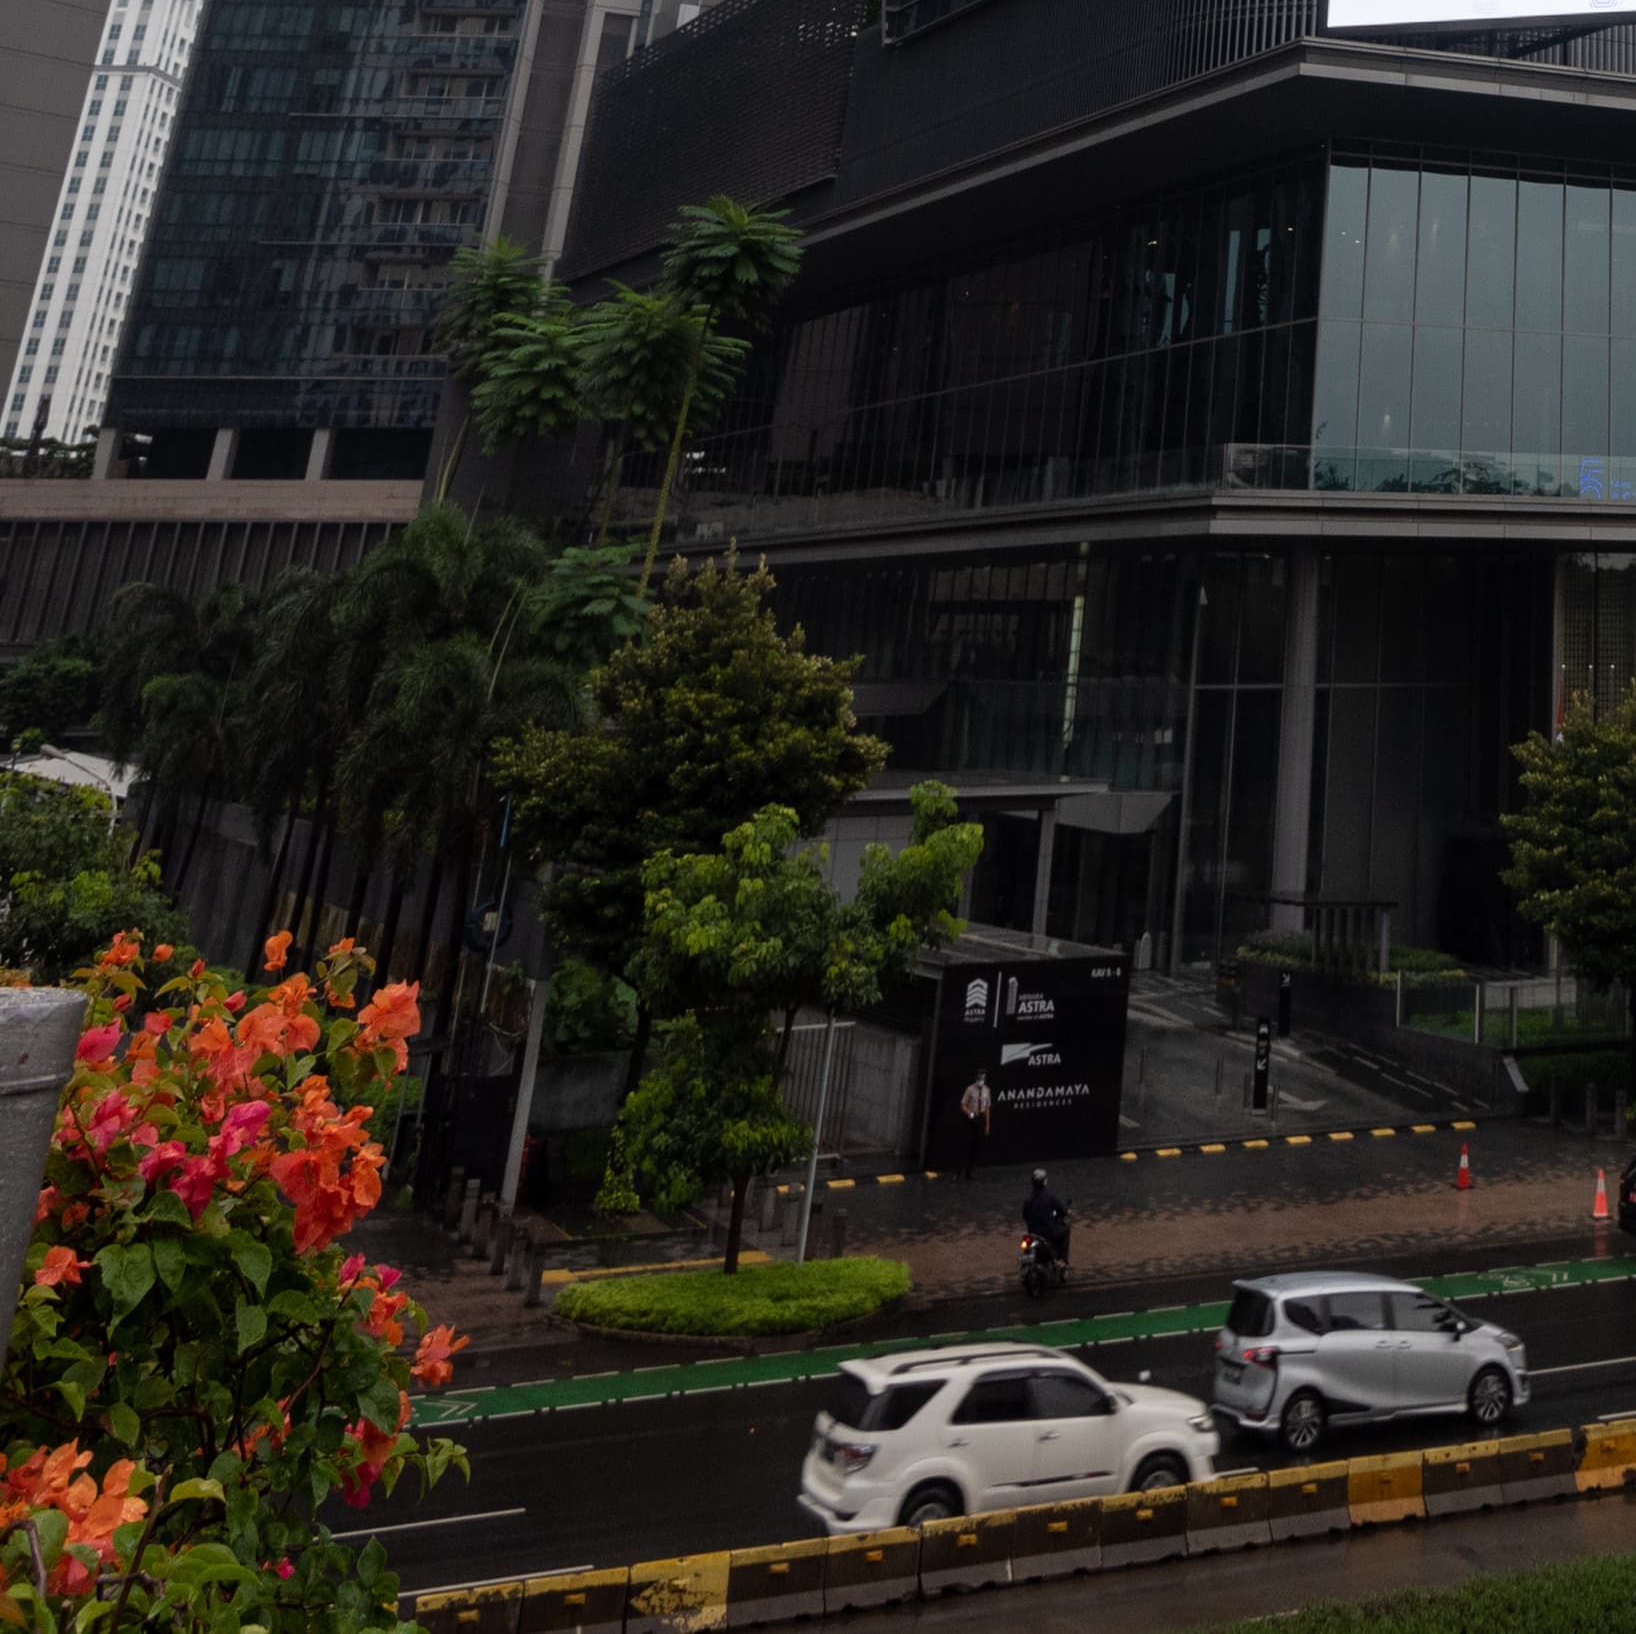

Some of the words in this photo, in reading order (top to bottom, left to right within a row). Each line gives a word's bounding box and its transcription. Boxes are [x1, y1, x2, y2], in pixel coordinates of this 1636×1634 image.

[1018, 999, 1055, 1014] ASTRA
[1027, 1053, 1062, 1066] ASTRA
[997, 1083, 1090, 1102] ANANDAMAYA
